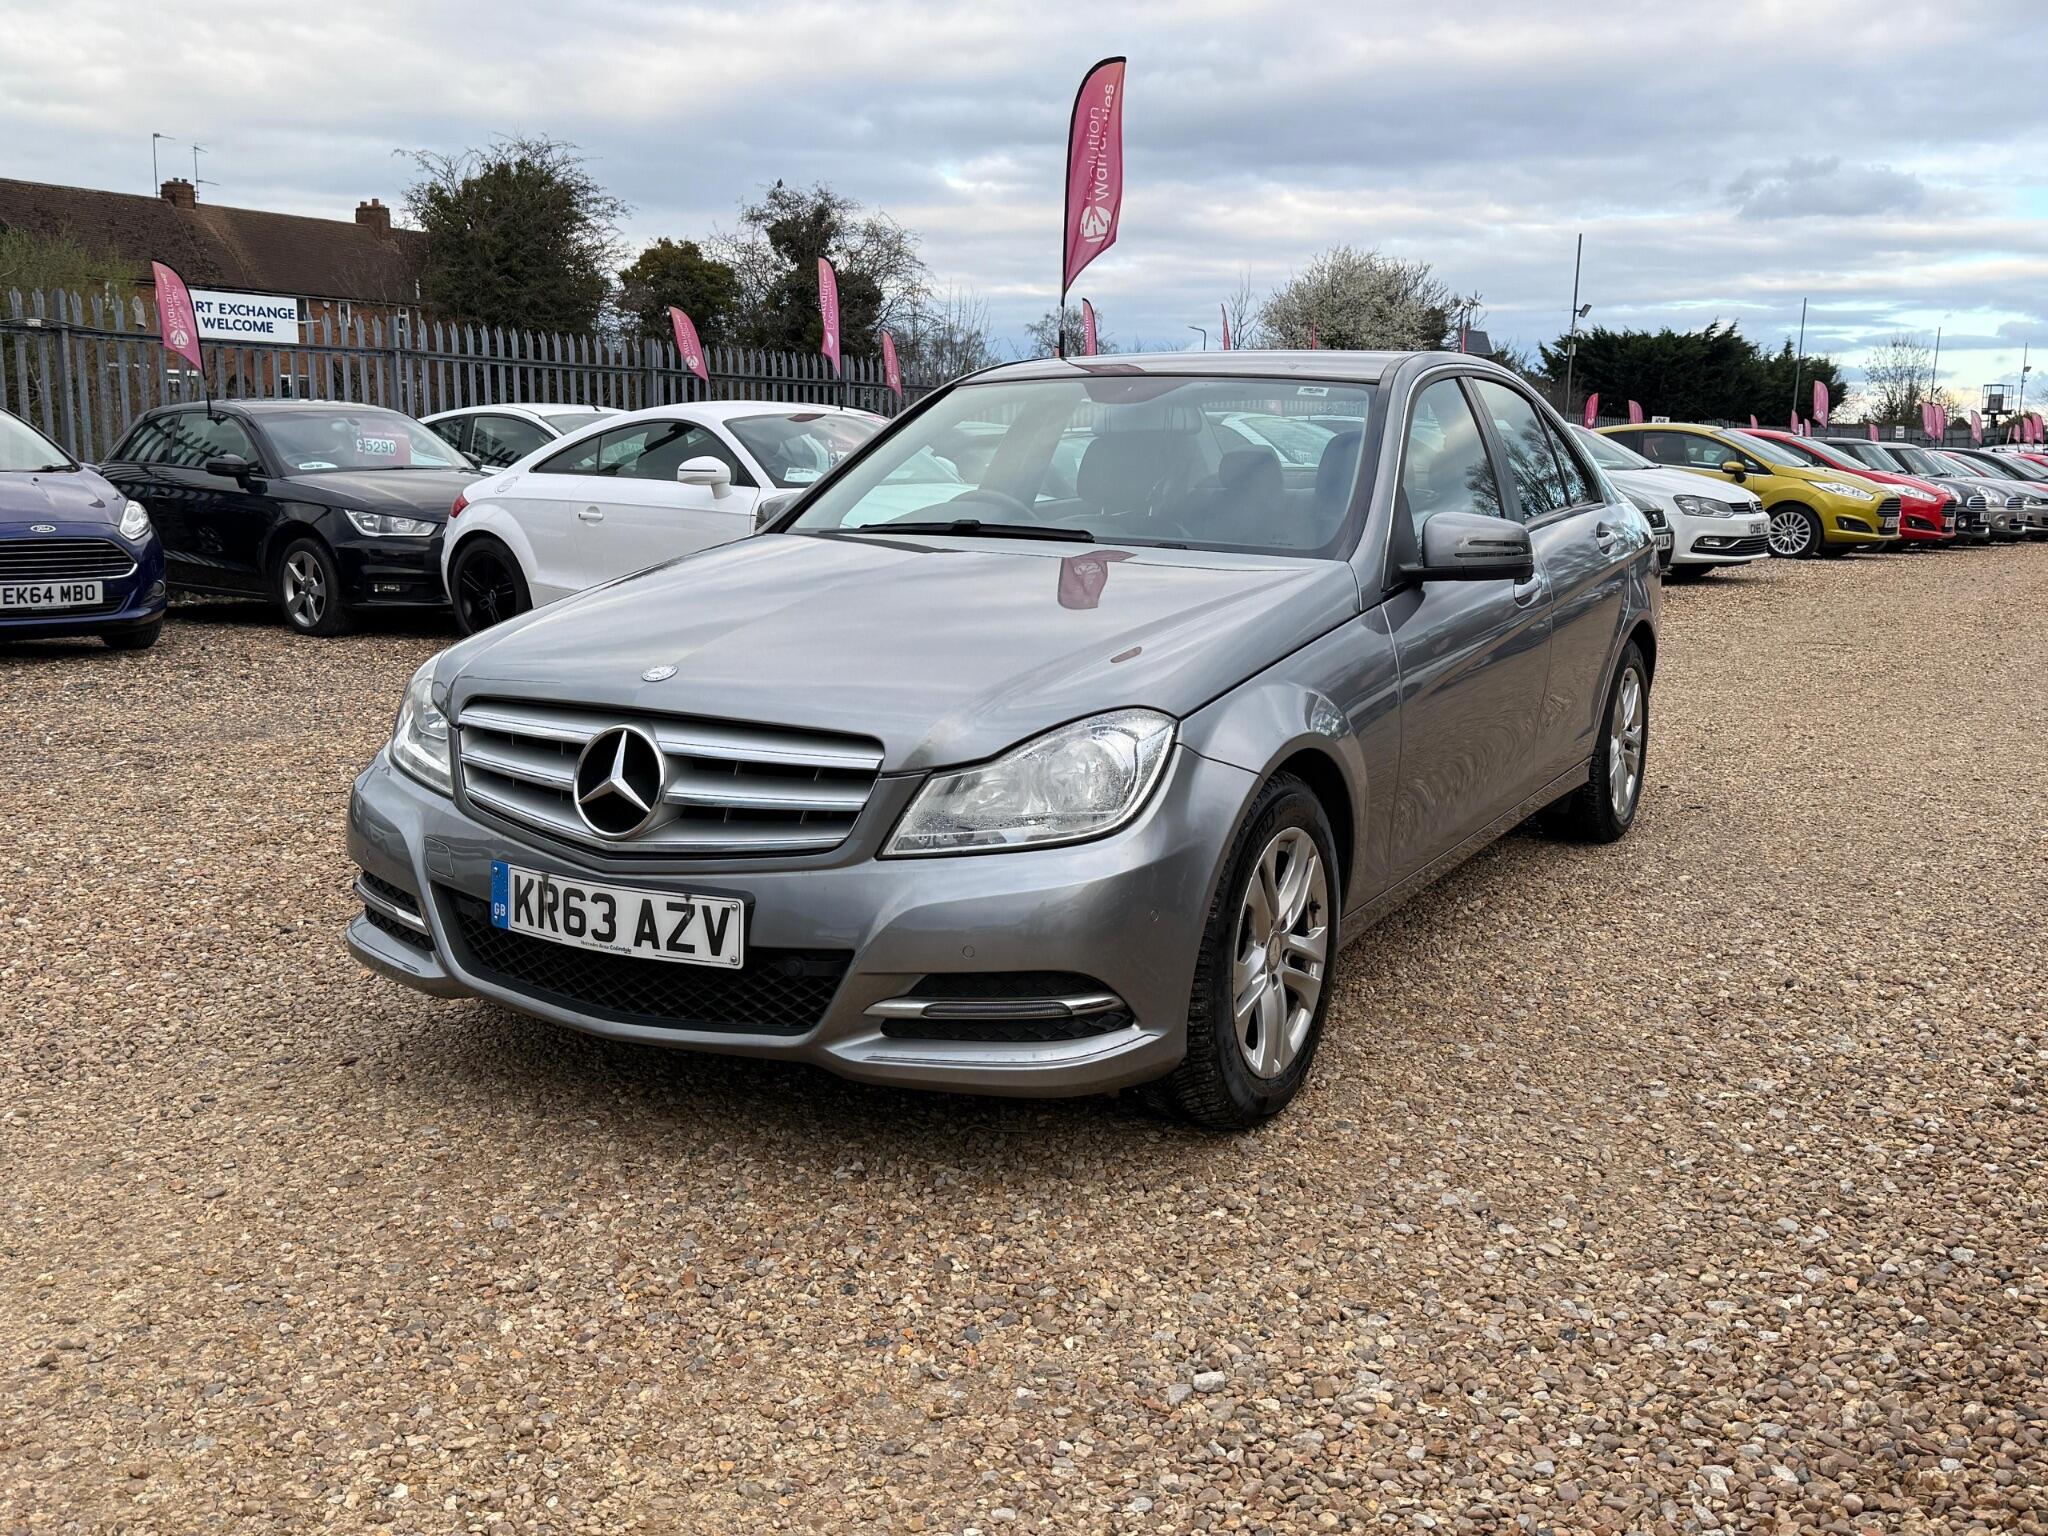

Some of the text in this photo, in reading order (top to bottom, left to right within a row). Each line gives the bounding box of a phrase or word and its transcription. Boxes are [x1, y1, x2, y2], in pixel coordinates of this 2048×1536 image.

[1095, 84, 1114, 201] Warries
[219, 303, 295, 320] EXCHANGE
[202, 316, 274, 333] WELCOME
[2, 584, 95, 604] EK64 MBO
[494, 902, 506, 917] GB
[514, 875, 730, 957] KR63 AZV
